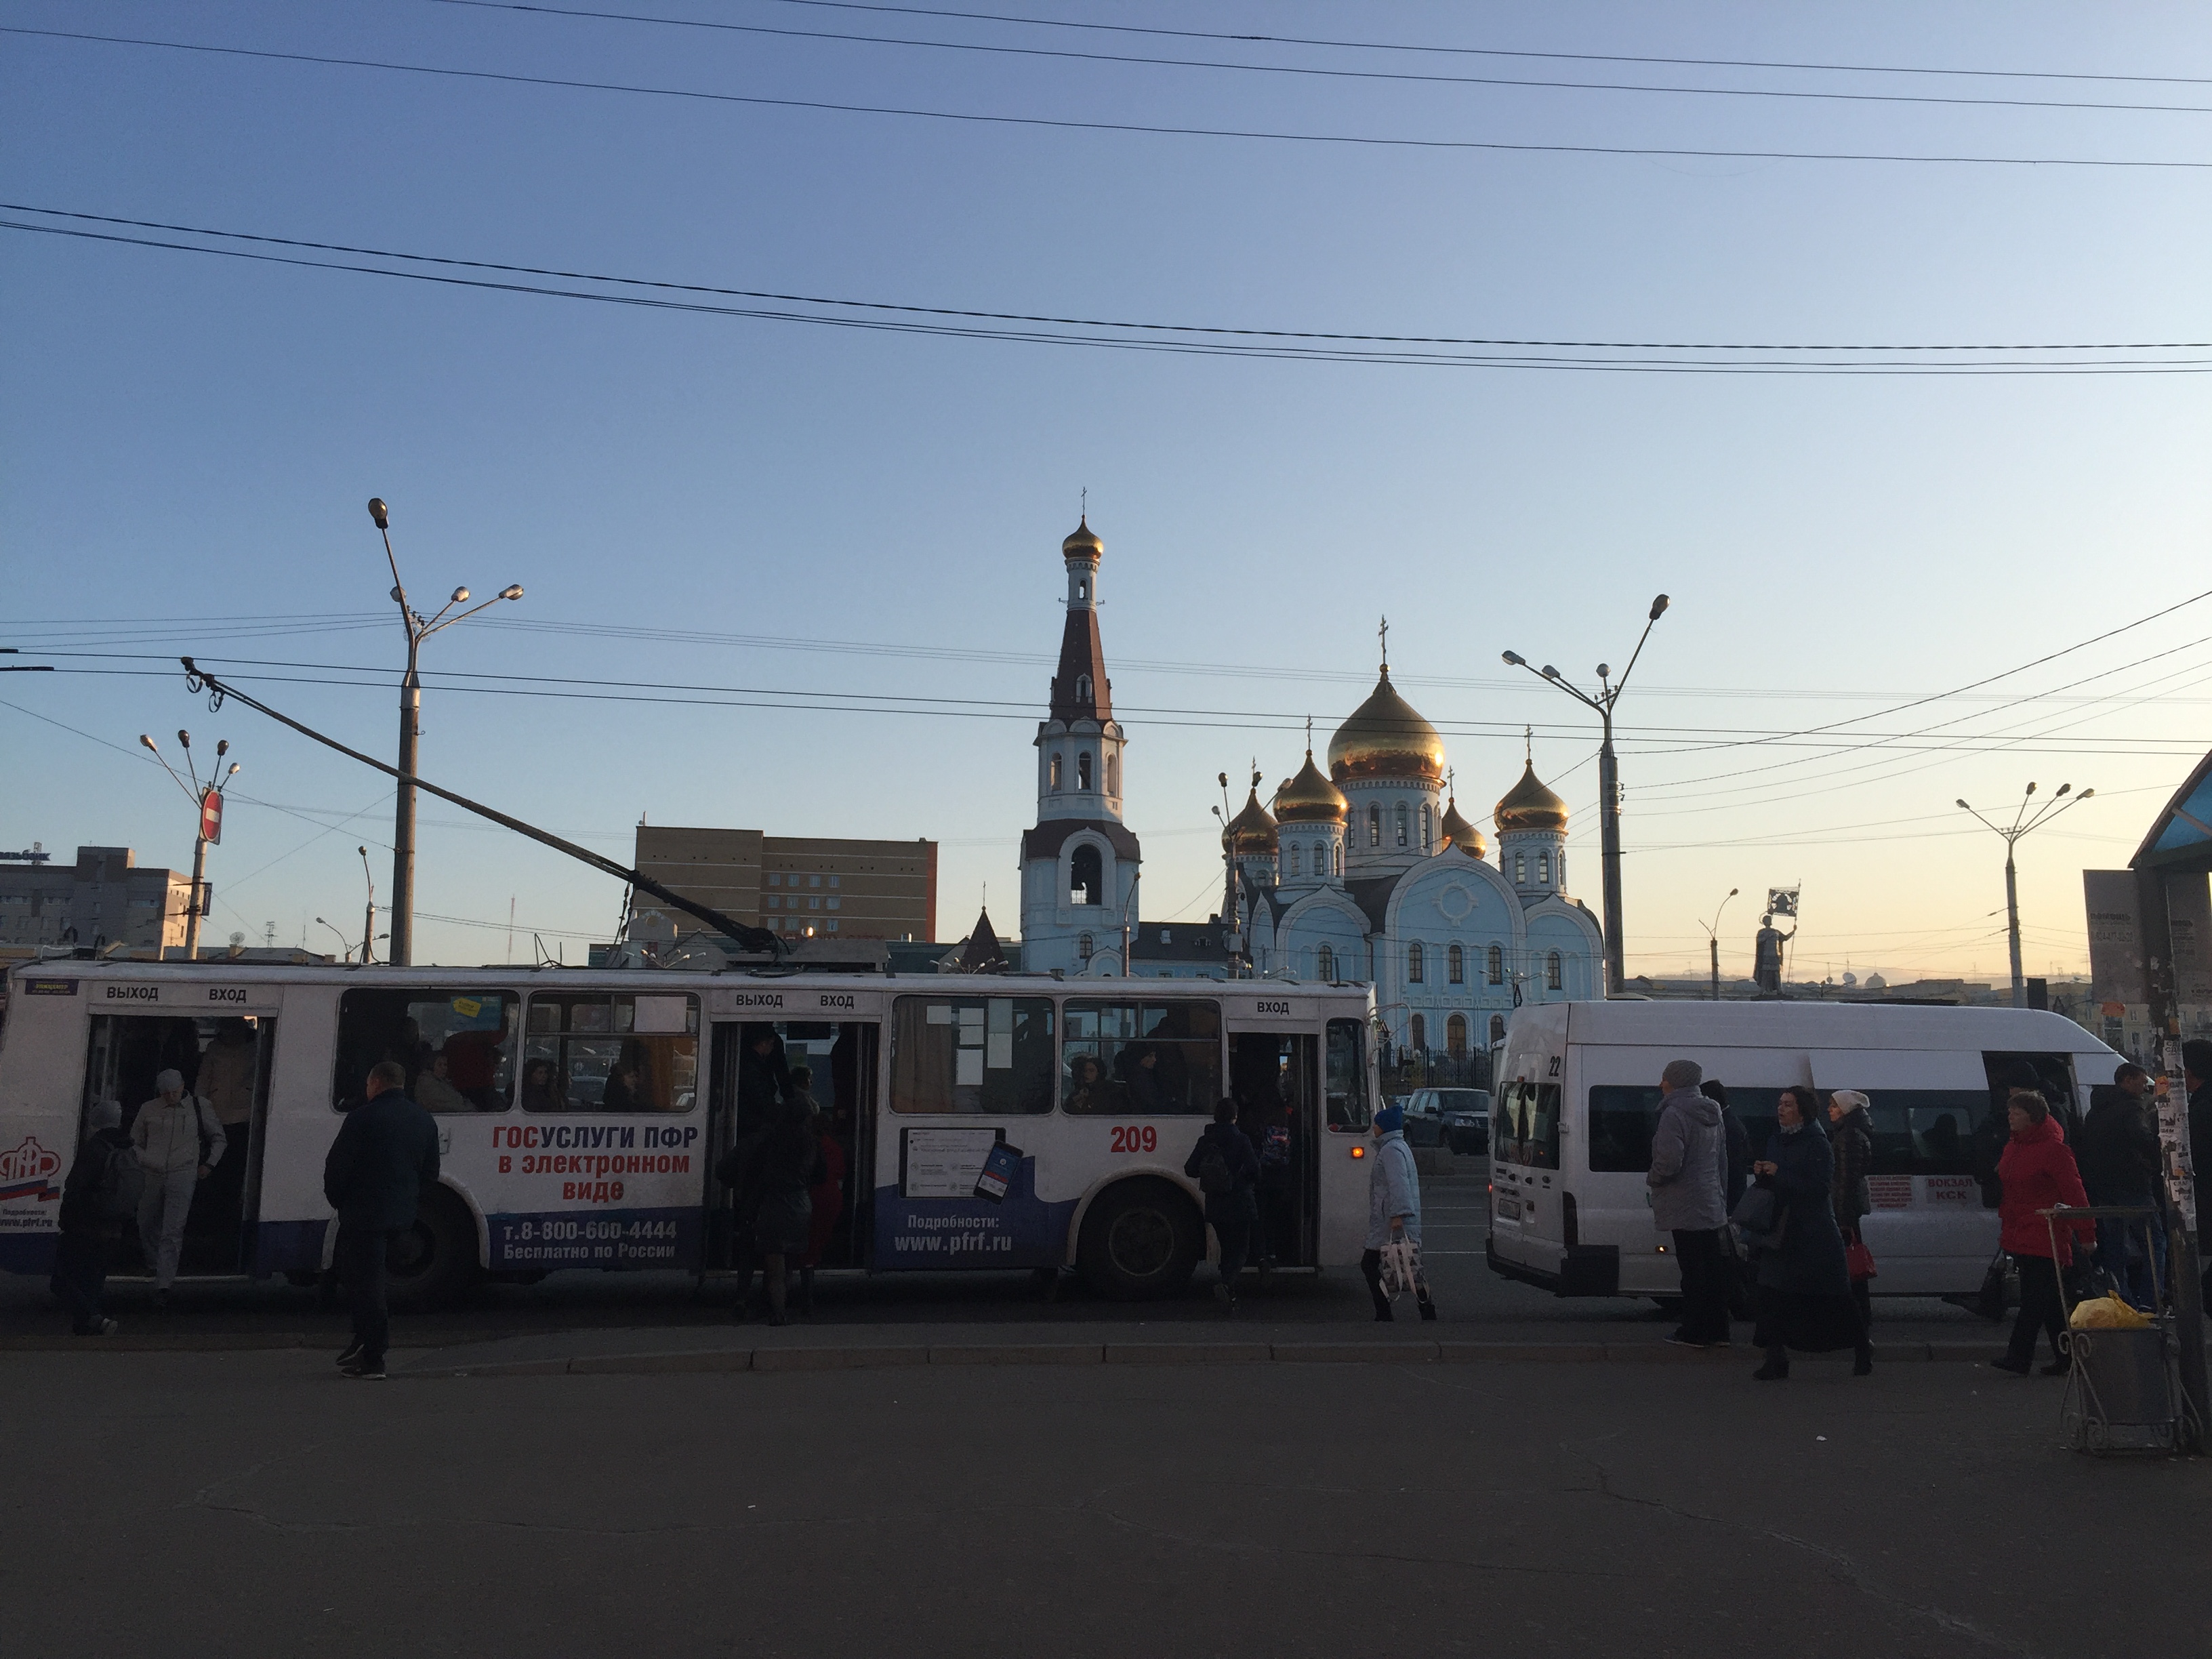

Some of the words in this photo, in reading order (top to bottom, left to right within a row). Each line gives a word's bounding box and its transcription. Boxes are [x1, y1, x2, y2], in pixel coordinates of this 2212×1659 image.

[107, 986, 159, 1002] ВЫХОД
[209, 988, 247, 1003] ВХОД
[736, 994, 783, 1008] ВЫХОД
[820, 995, 855, 1009] ВХОД
[1257, 1002, 1290, 1015] ВХОД
[1549, 1055, 1561, 1077] 22
[493, 1126, 635, 1149] ГОСУСЛУГИ
[644, 1126, 699, 1149] ПФР
[1111, 1126, 1158, 1153] 209
[498, 1155, 512, 1174] в
[521, 1155, 690, 1179] электронном
[1928, 1178, 1973, 1187] ВОКЗАЛ
[562, 1181, 625, 1203] виде
[1936, 1191, 1967, 1200] КСК
[907, 1214, 1000, 1231] Подробности:
[504, 1244, 590, 1259] Бесплатно
[594, 1246, 613, 1258] по
[618, 1242, 676, 1258] России
[894, 1231, 1012, 1256] www.pfrf.ru
